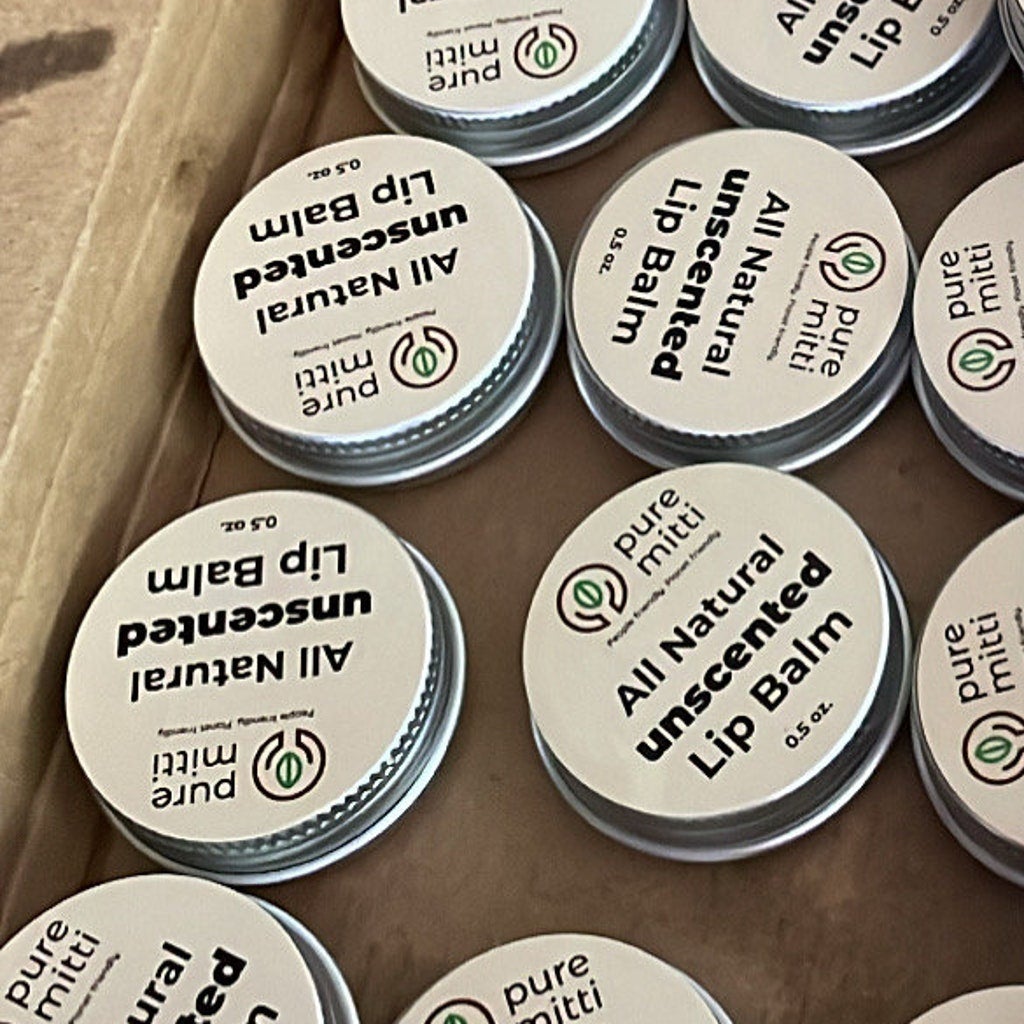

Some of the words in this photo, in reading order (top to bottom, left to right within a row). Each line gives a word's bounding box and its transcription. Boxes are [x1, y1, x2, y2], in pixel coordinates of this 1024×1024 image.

[849, 17, 903, 70] Lip
[929, 13, 951, 36] 0.5
[425, 36, 499, 72] mitti
[427, 57, 501, 92] pure
[651, 177, 702, 235] Lip
[751, 189, 790, 239] All
[597, 252, 614, 274] oz.
[608, 226, 628, 251] 0.5
[610, 244, 676, 345] Balm
[648, 168, 750, 382] unscented
[940, 249, 977, 320] pure
[963, 242, 1002, 313] mitti
[700, 245, 773, 378] Natural
[787, 298, 829, 373] mitti
[819, 303, 859, 377] pure
[219, 519, 246, 532] oz.
[249, 514, 277, 531] 0.5
[613, 488, 680, 560] pure
[636, 501, 706, 577] mitti
[146, 554, 264, 597] Balm
[278, 539, 346, 581] Lip
[116, 588, 372, 658] unscented
[616, 657, 666, 718] All
[658, 532, 785, 664] Natural
[129, 649, 284, 703] Natural
[298, 639, 354, 679] All
[635, 550, 833, 762] unscented
[687, 714, 755, 780] Lip
[748, 610, 854, 713] Balm
[784, 720, 811, 749] 0.5
[809, 702, 834, 724] oz.
[150, 769, 236, 809] pure
[151, 741, 237, 782] mitti
[4, 919, 69, 1010] pure
[34, 929, 101, 1022] mitti
[503, 953, 589, 1016] pure
